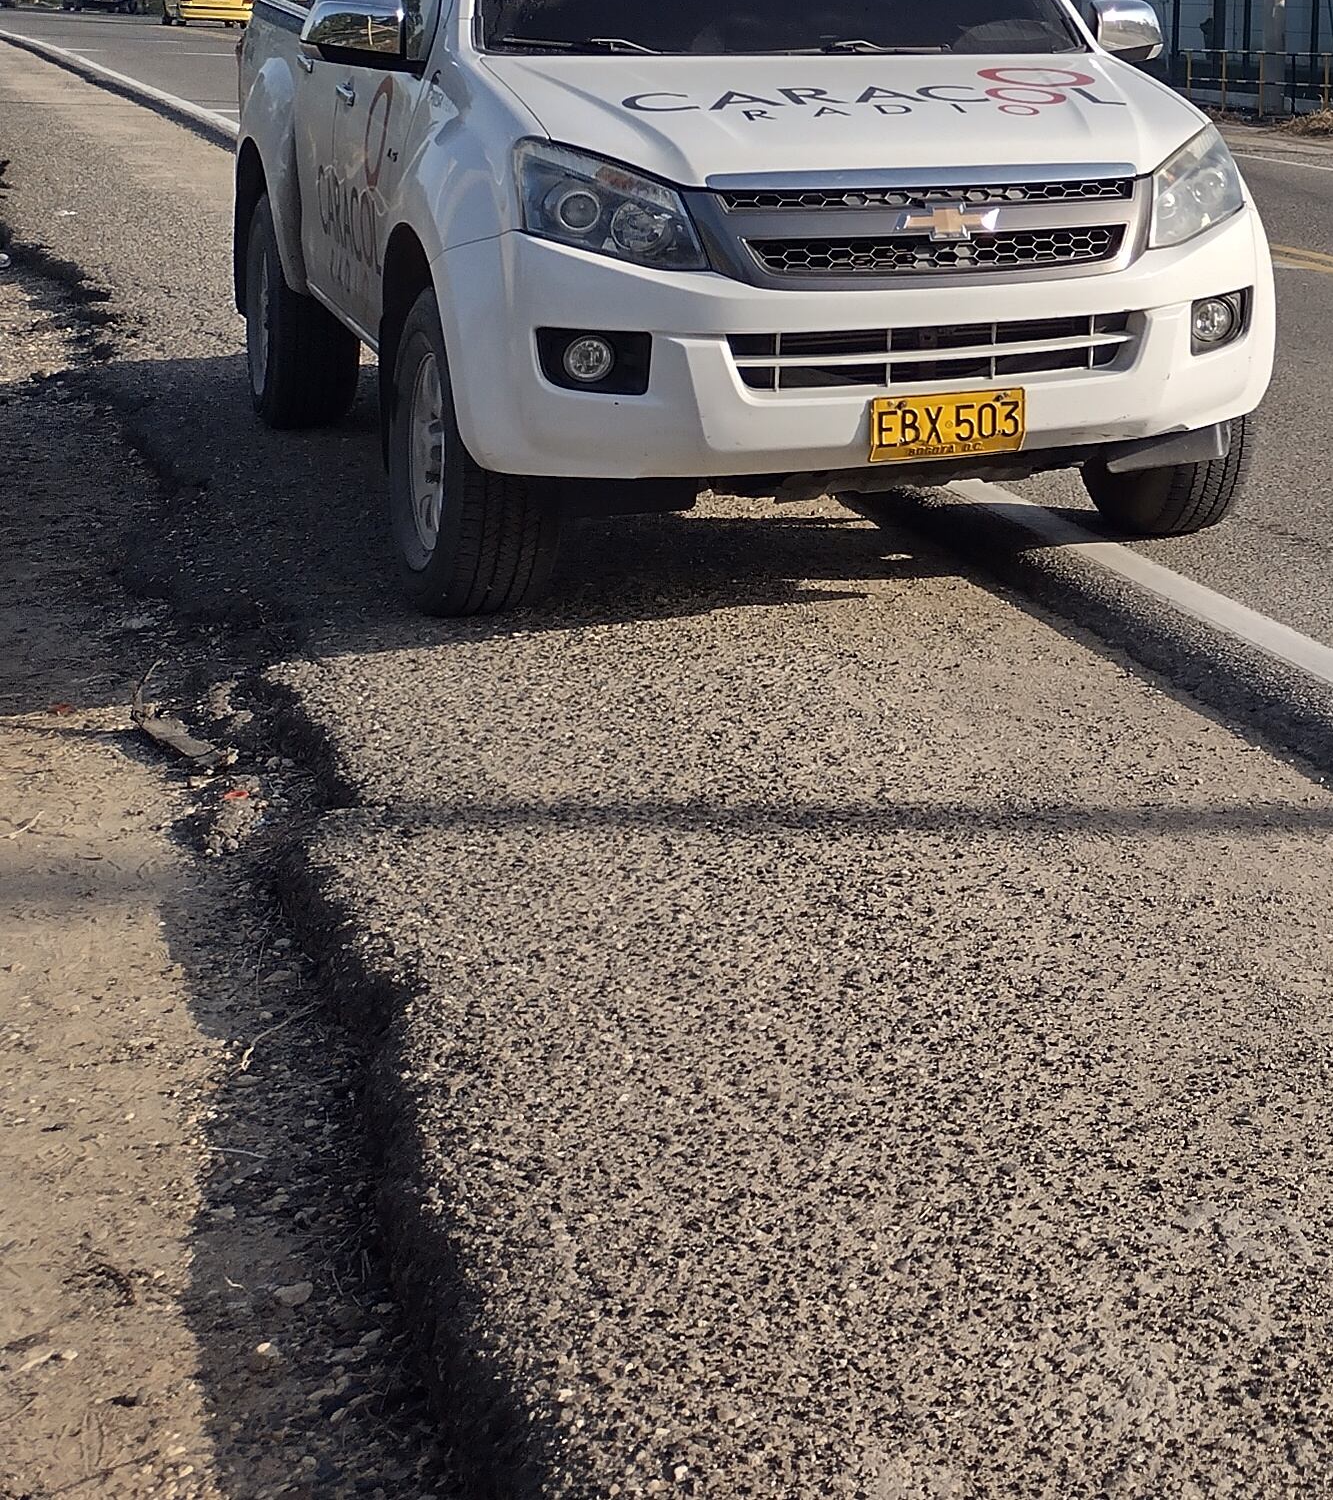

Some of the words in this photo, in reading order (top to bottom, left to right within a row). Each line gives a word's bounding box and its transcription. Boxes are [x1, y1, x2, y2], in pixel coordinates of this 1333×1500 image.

[620, 85, 1126, 112] CARACOL
[741, 103, 1040, 122] RADIO
[878, 406, 944, 448] EBX
[954, 401, 1020, 443] 503
